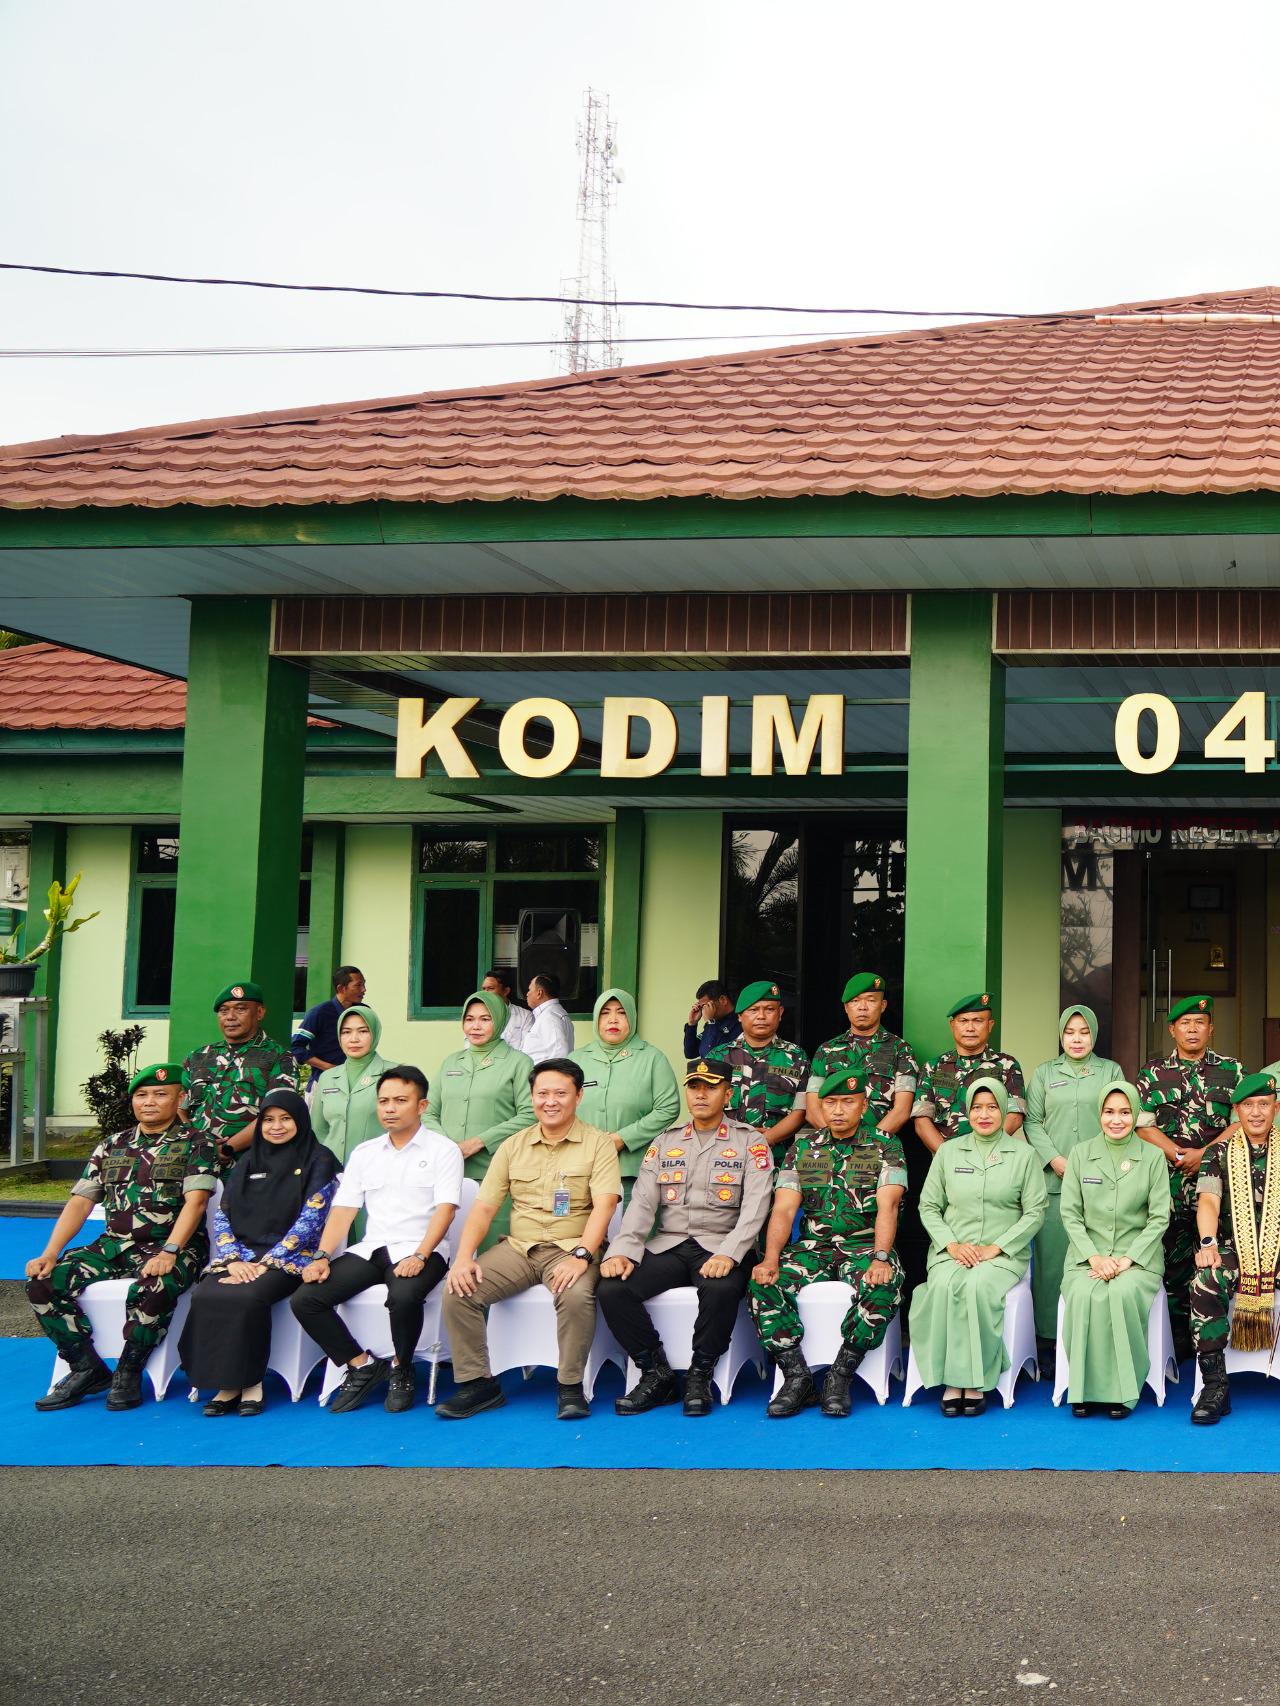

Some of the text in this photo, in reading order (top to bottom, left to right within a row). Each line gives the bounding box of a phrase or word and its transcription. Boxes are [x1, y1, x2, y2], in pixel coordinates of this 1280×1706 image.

[395, 694, 845, 778] KODIM
[1074, 816, 1162, 844] BAGIMU
[1171, 816, 1257, 844] NEGERI
[788, 1069, 799, 1077] AD
[661, 1160, 686, 1168] SILPA
[714, 1161, 743, 1169] POLRI
[866, 1162, 879, 1170] AD
[1240, 1276, 1259, 1286] KODIM
